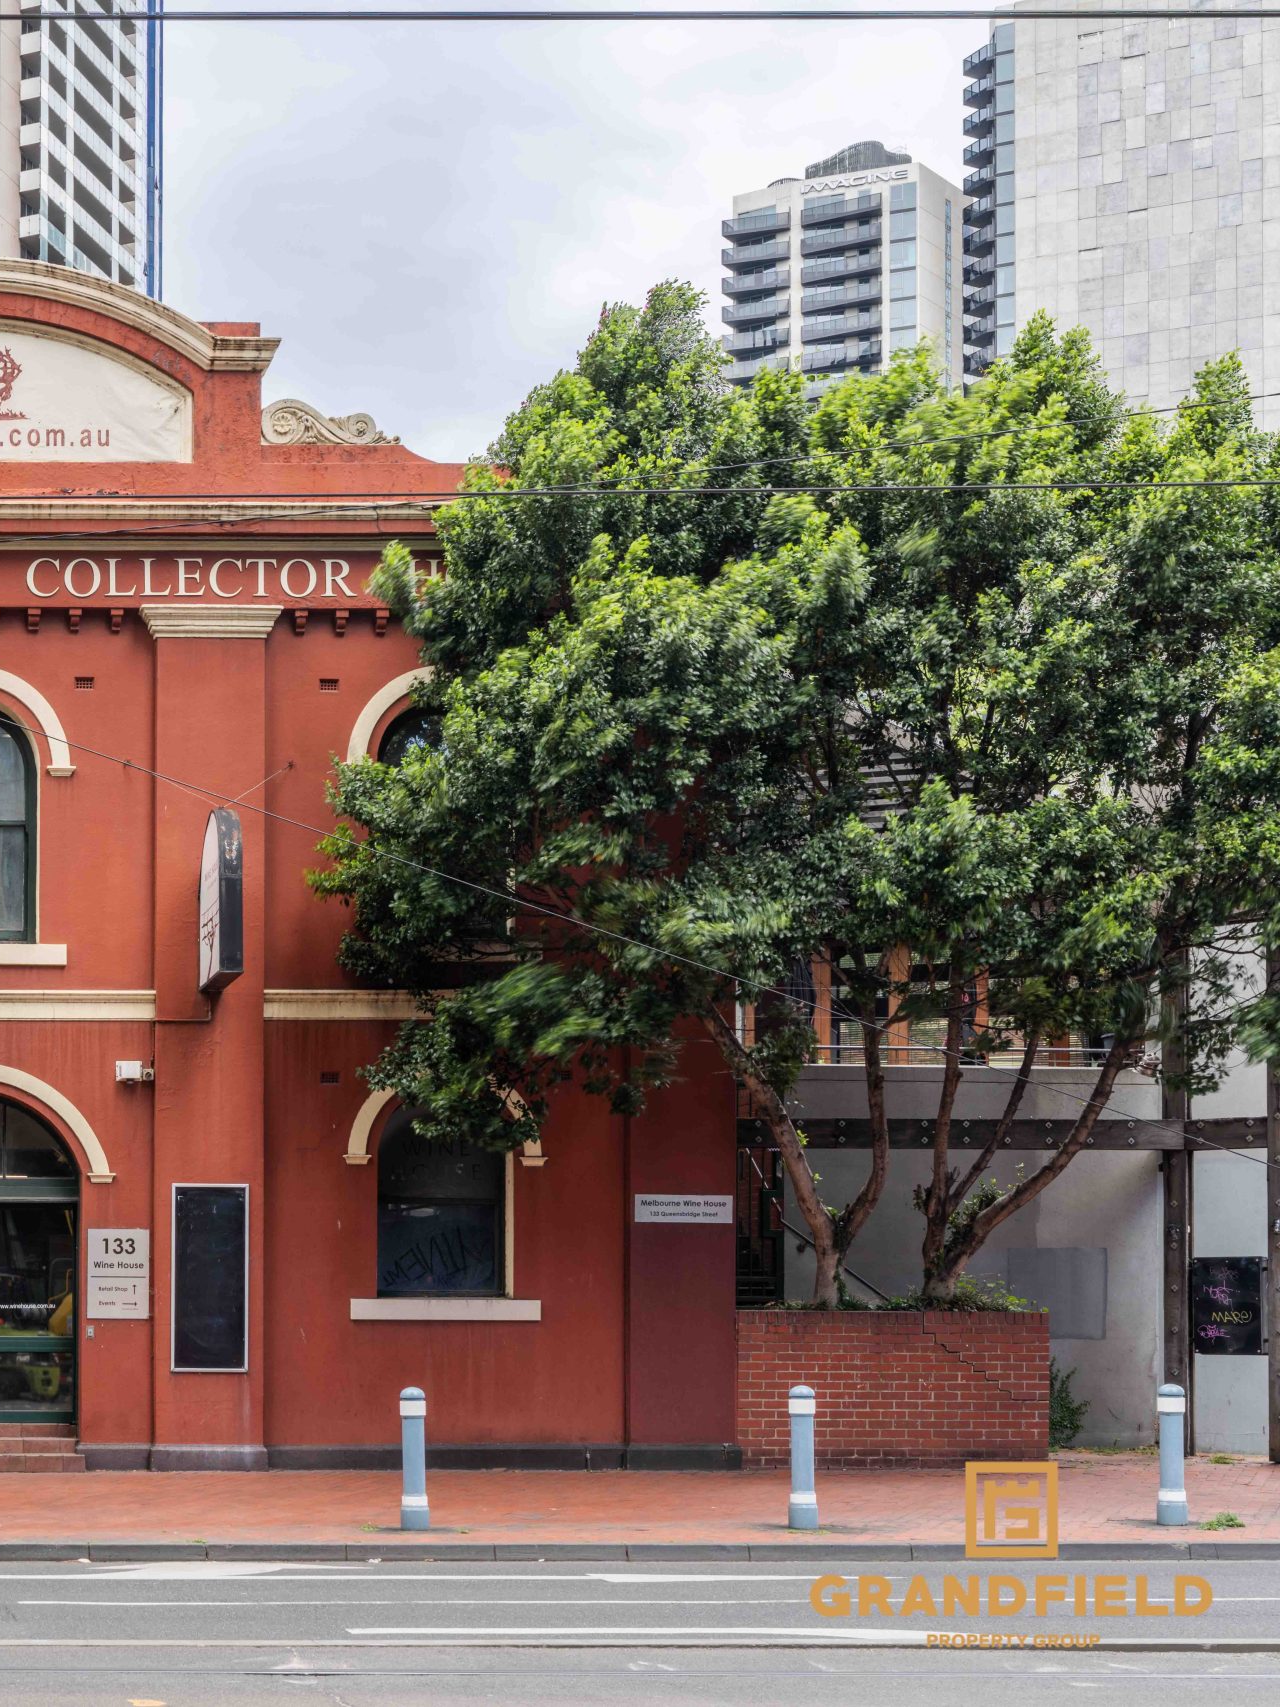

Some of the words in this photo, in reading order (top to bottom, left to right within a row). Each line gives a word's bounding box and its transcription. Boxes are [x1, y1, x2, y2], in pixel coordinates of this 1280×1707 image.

[24, 556, 358, 599] COLLECTOR
[640, 1199, 681, 1207] Melbourne
[703, 1200, 727, 1208] House
[102, 1237, 136, 1255] 133
[93, 1261, 115, 1269] Wine
[117, 1261, 144, 1269] House
